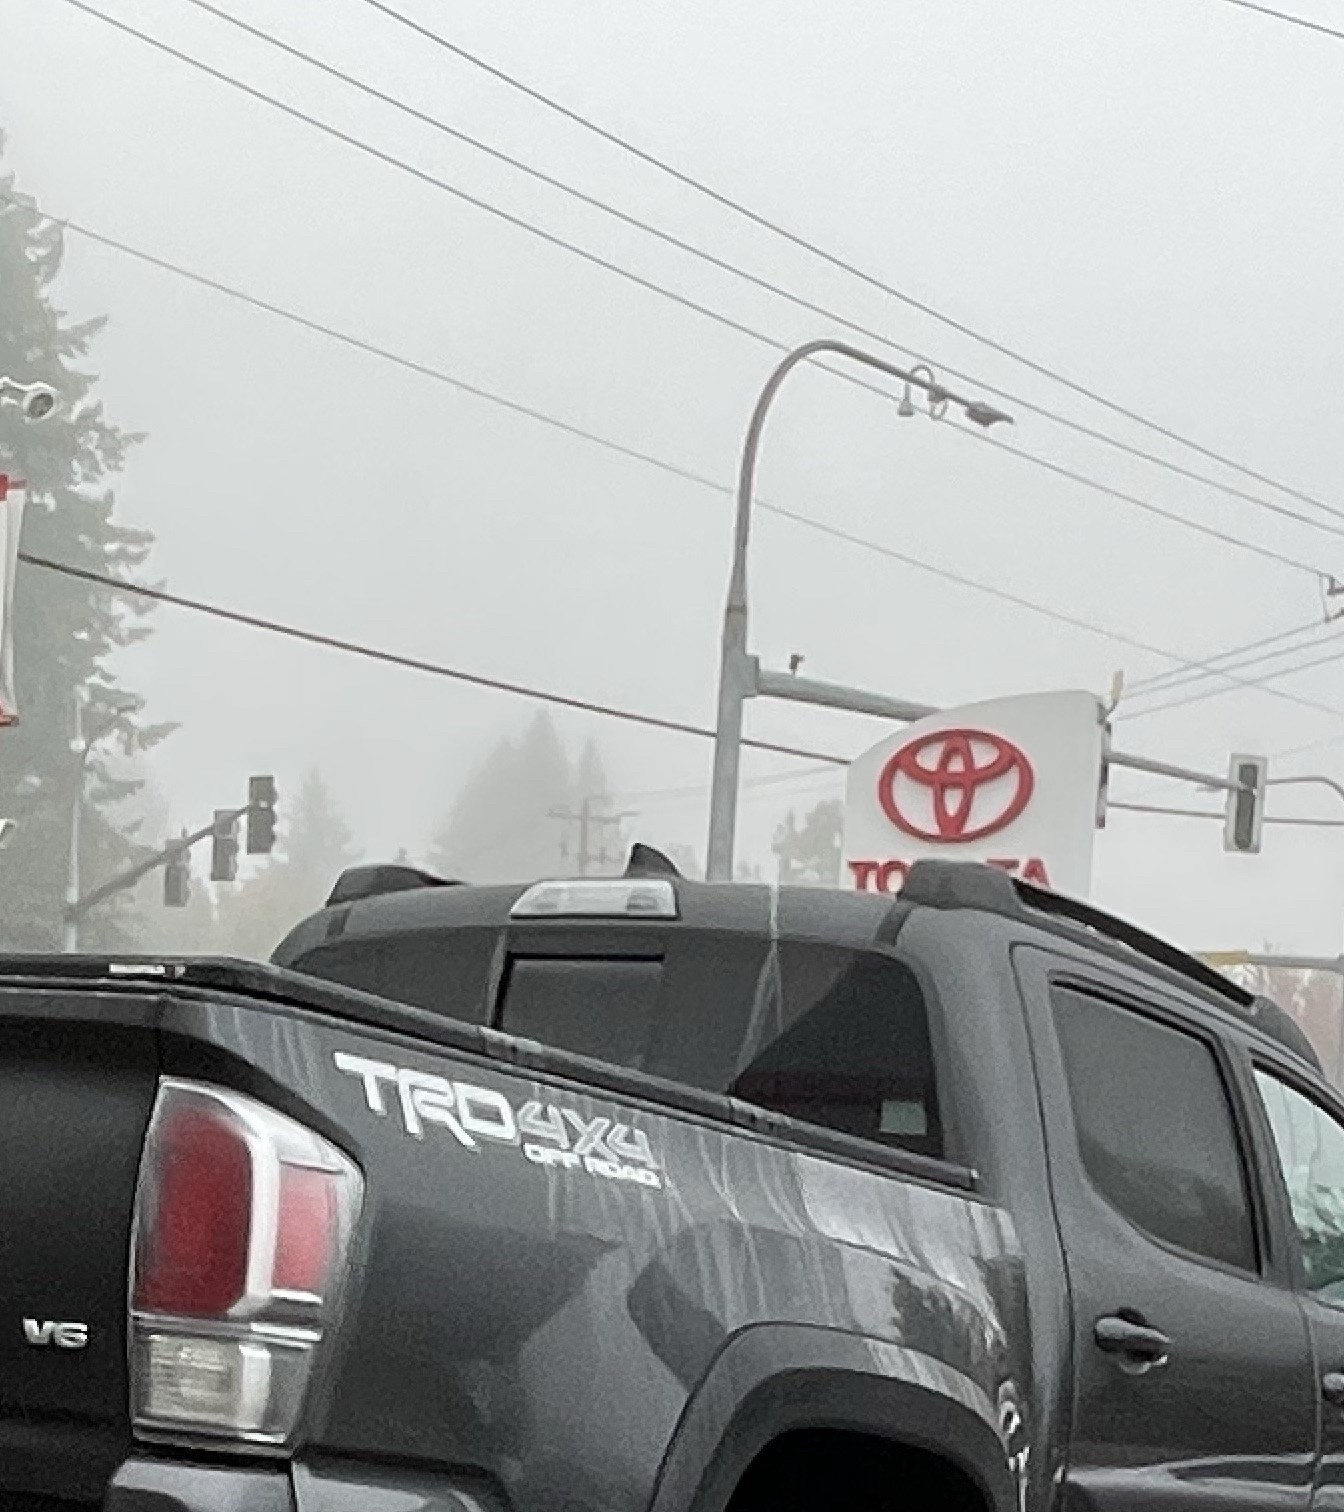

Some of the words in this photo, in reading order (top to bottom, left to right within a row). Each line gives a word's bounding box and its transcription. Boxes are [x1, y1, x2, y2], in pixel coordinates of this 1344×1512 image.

[846, 858, 1050, 892] TOA
[333, 1051, 519, 1152] TRD
[523, 1142, 582, 1169] OFF
[584, 1155, 662, 1190] ROAD
[22, 1315, 91, 1350] V6
